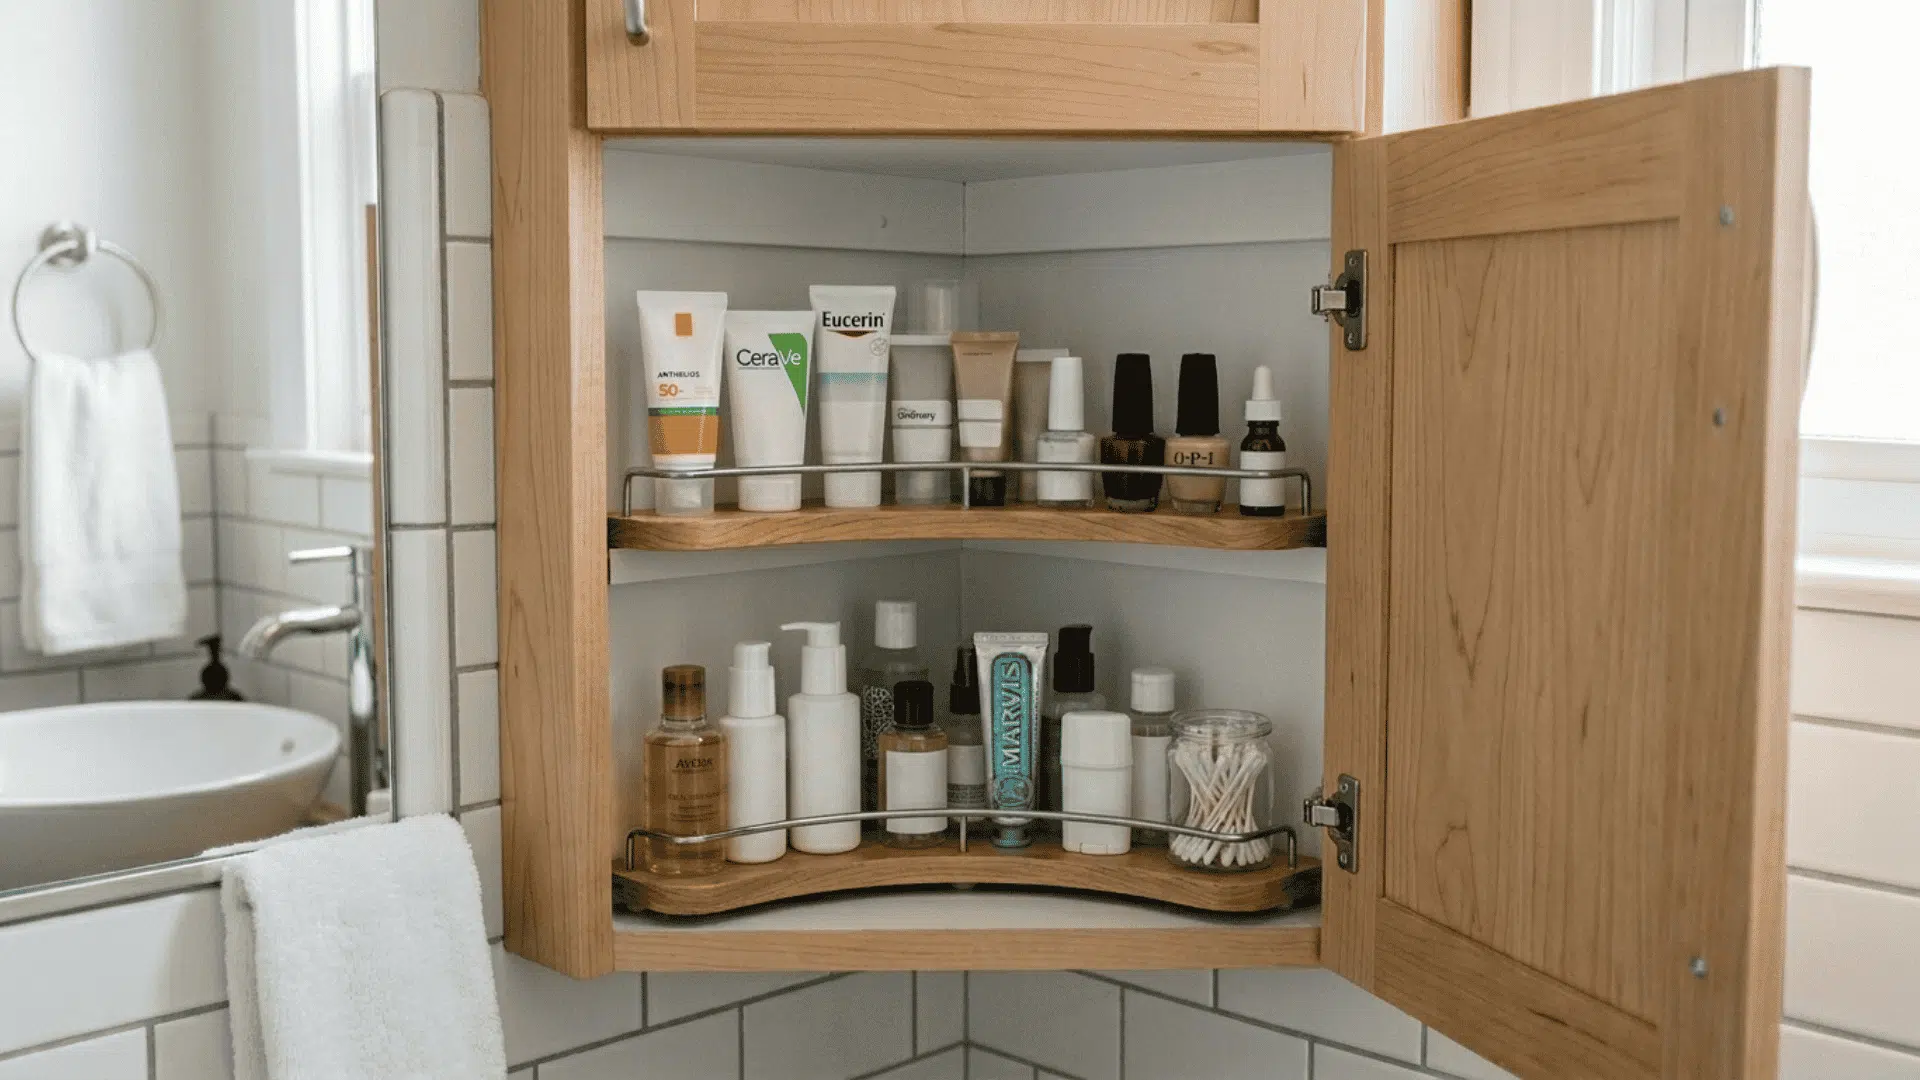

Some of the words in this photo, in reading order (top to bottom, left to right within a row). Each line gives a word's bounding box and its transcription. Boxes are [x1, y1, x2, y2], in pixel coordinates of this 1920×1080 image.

[822, 311, 884, 327] Eucerin
[736, 348, 802, 367] CeraVe
[1001, 660, 1022, 767] MARVIS
